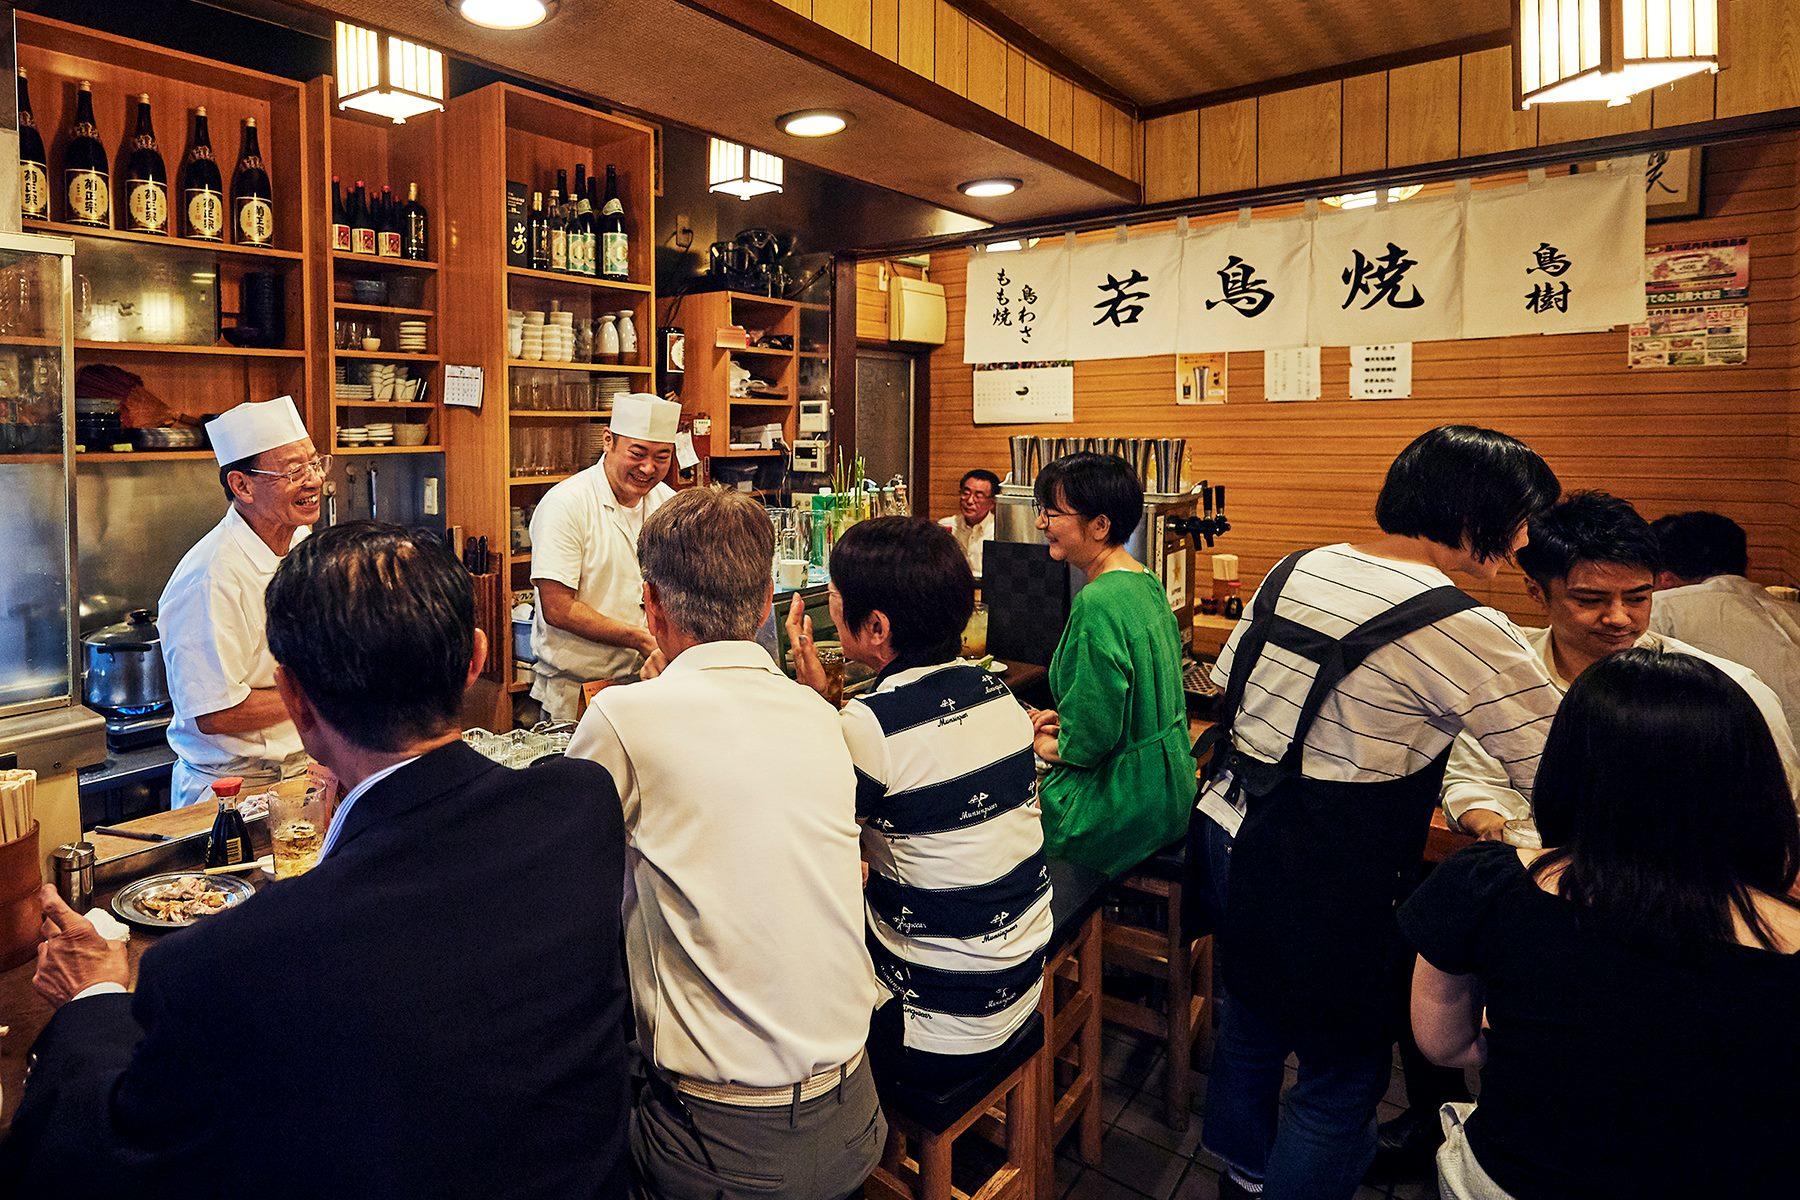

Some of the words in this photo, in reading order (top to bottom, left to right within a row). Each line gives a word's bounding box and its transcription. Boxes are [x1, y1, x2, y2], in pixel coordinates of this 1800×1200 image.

[992, 268, 1013, 327] もも焼
[1525, 242, 1572, 315] 鳥樹
[1018, 284, 1038, 344] 鳥わさ
